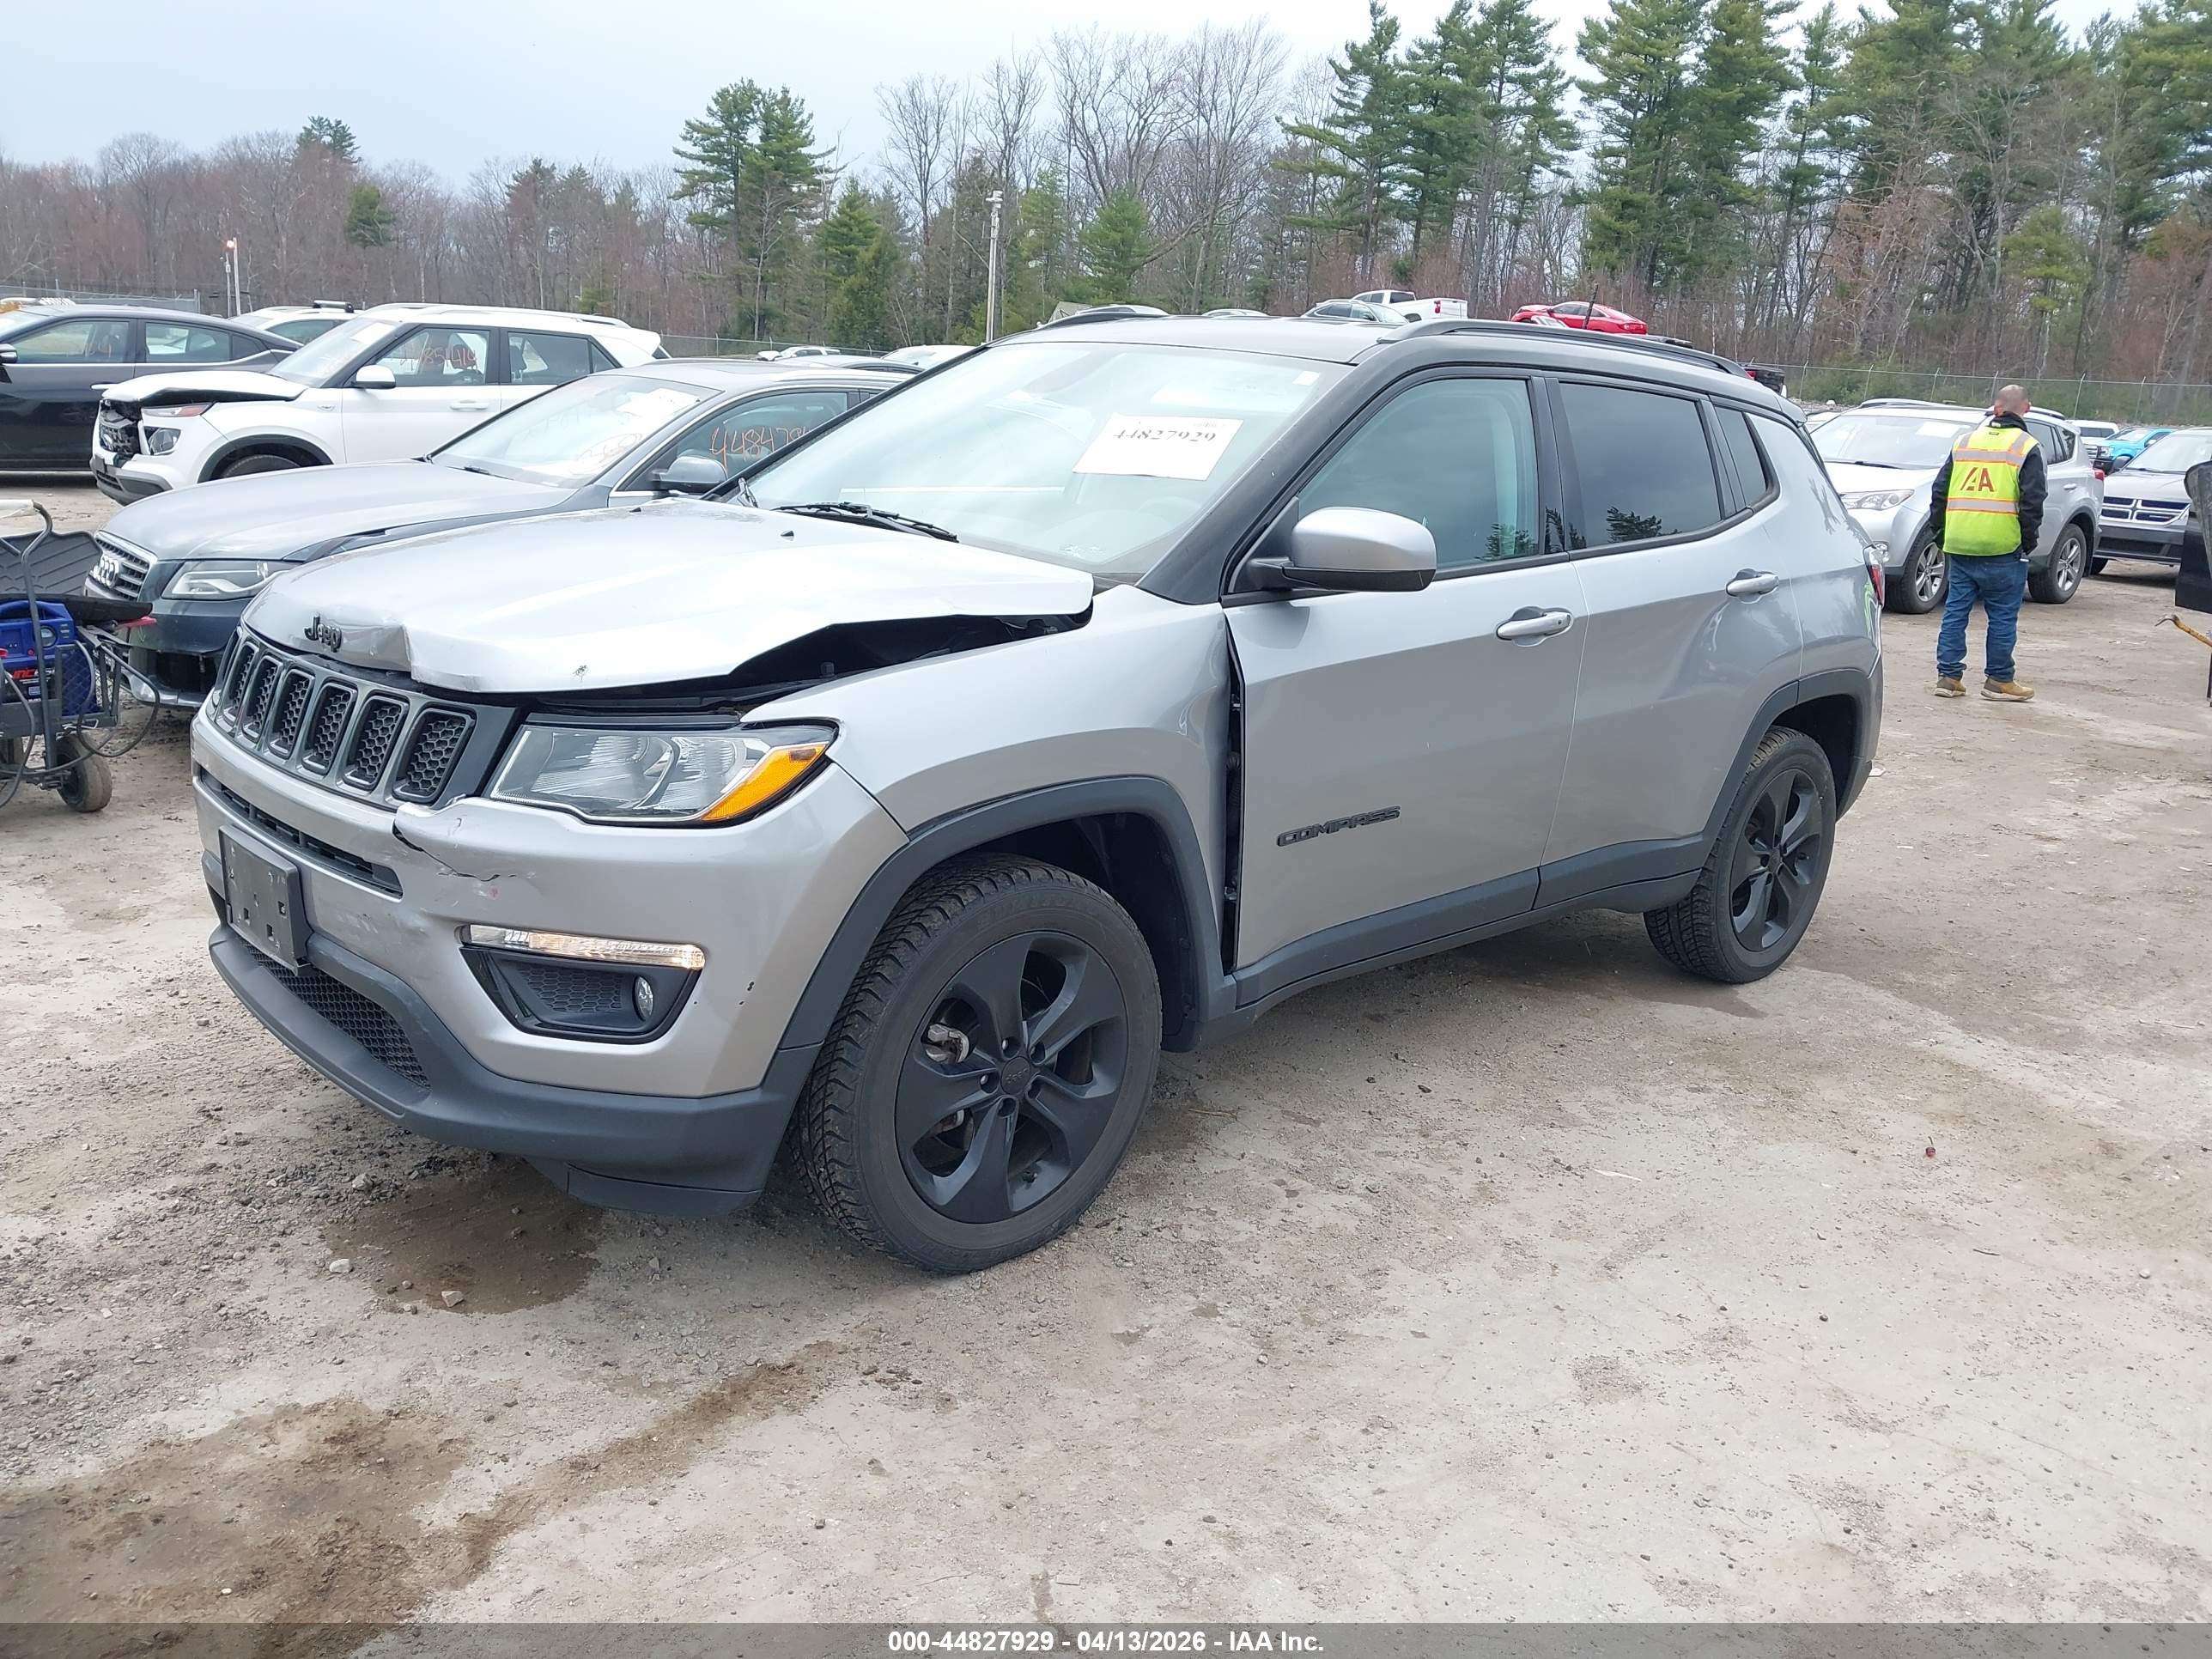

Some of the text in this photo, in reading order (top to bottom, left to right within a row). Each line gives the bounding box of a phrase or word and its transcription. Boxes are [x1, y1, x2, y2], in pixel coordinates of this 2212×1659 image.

[1112, 429, 1217, 441] 44827929
[304, 616, 342, 653] Jeep
[1277, 805, 1401, 847] COMPASS
